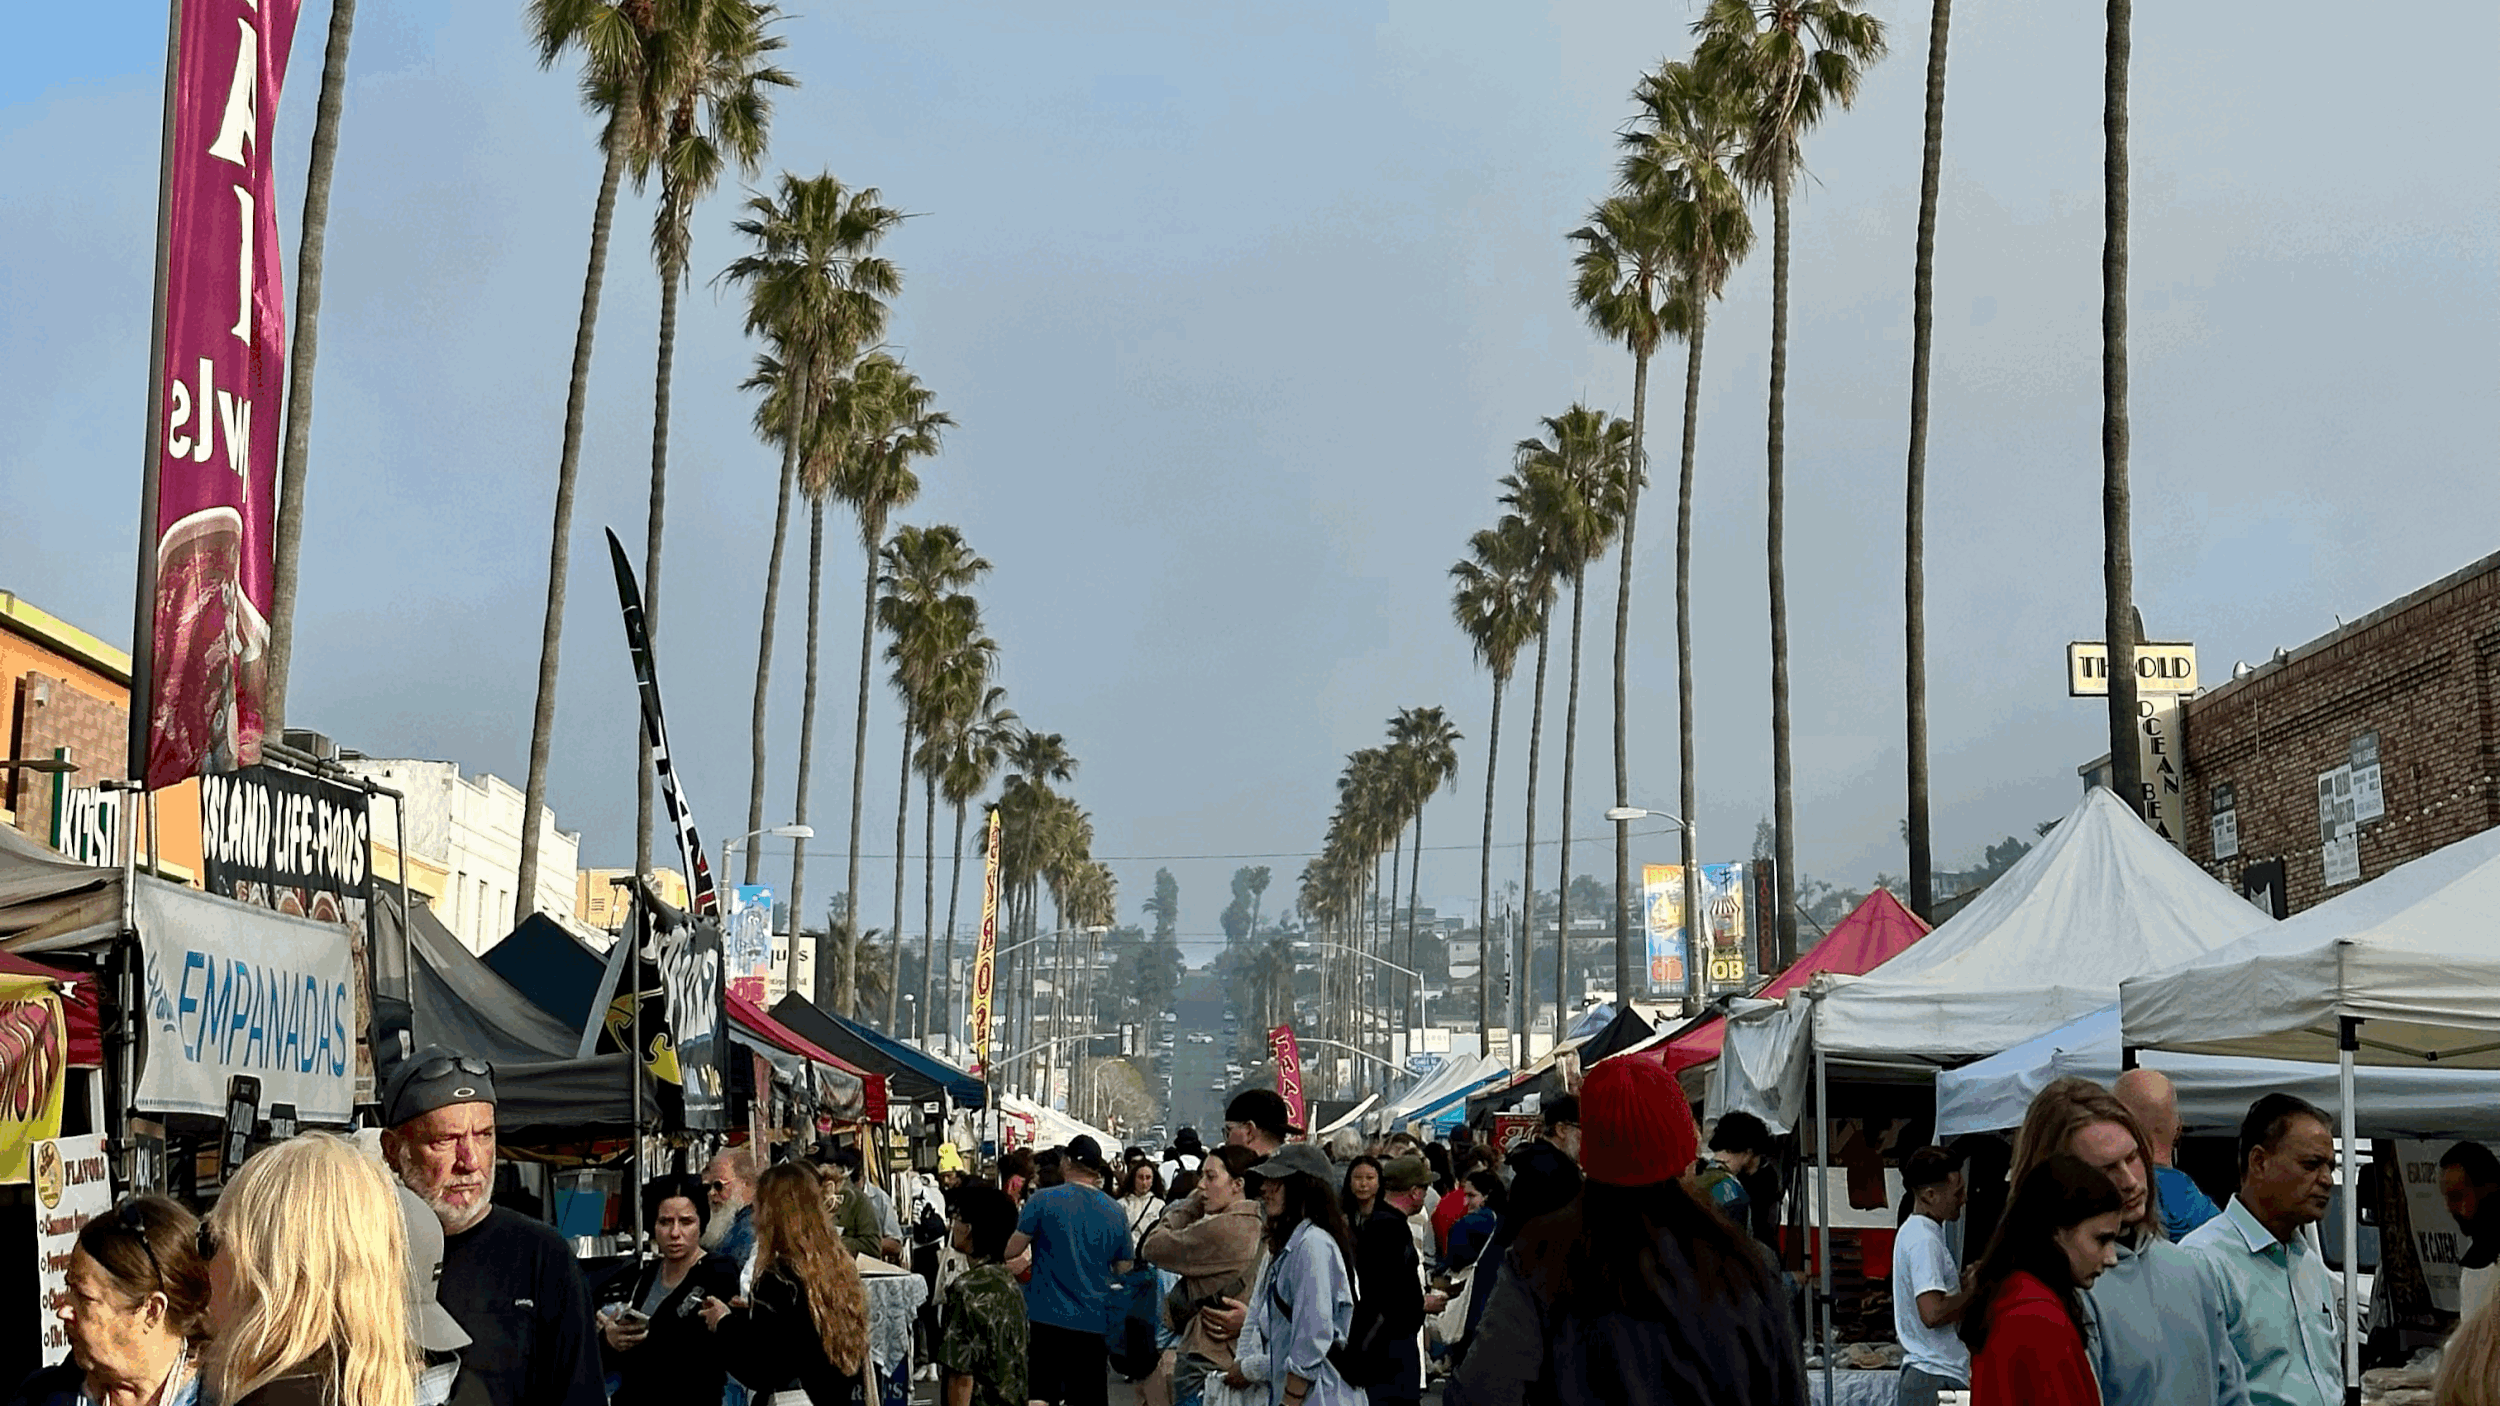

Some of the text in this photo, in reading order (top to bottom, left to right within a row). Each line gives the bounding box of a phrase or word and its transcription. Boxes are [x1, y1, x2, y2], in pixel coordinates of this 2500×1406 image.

[2136, 656, 2191, 679] OLD
[2137, 700, 2180, 795] OCEAN
[202, 773, 271, 870] ISLAND
[275, 790, 314, 876] LIFE
[2142, 783, 2179, 846] BEA
[1710, 960, 1745, 980] OB
[179, 950, 346, 1078] EMPANADAS
